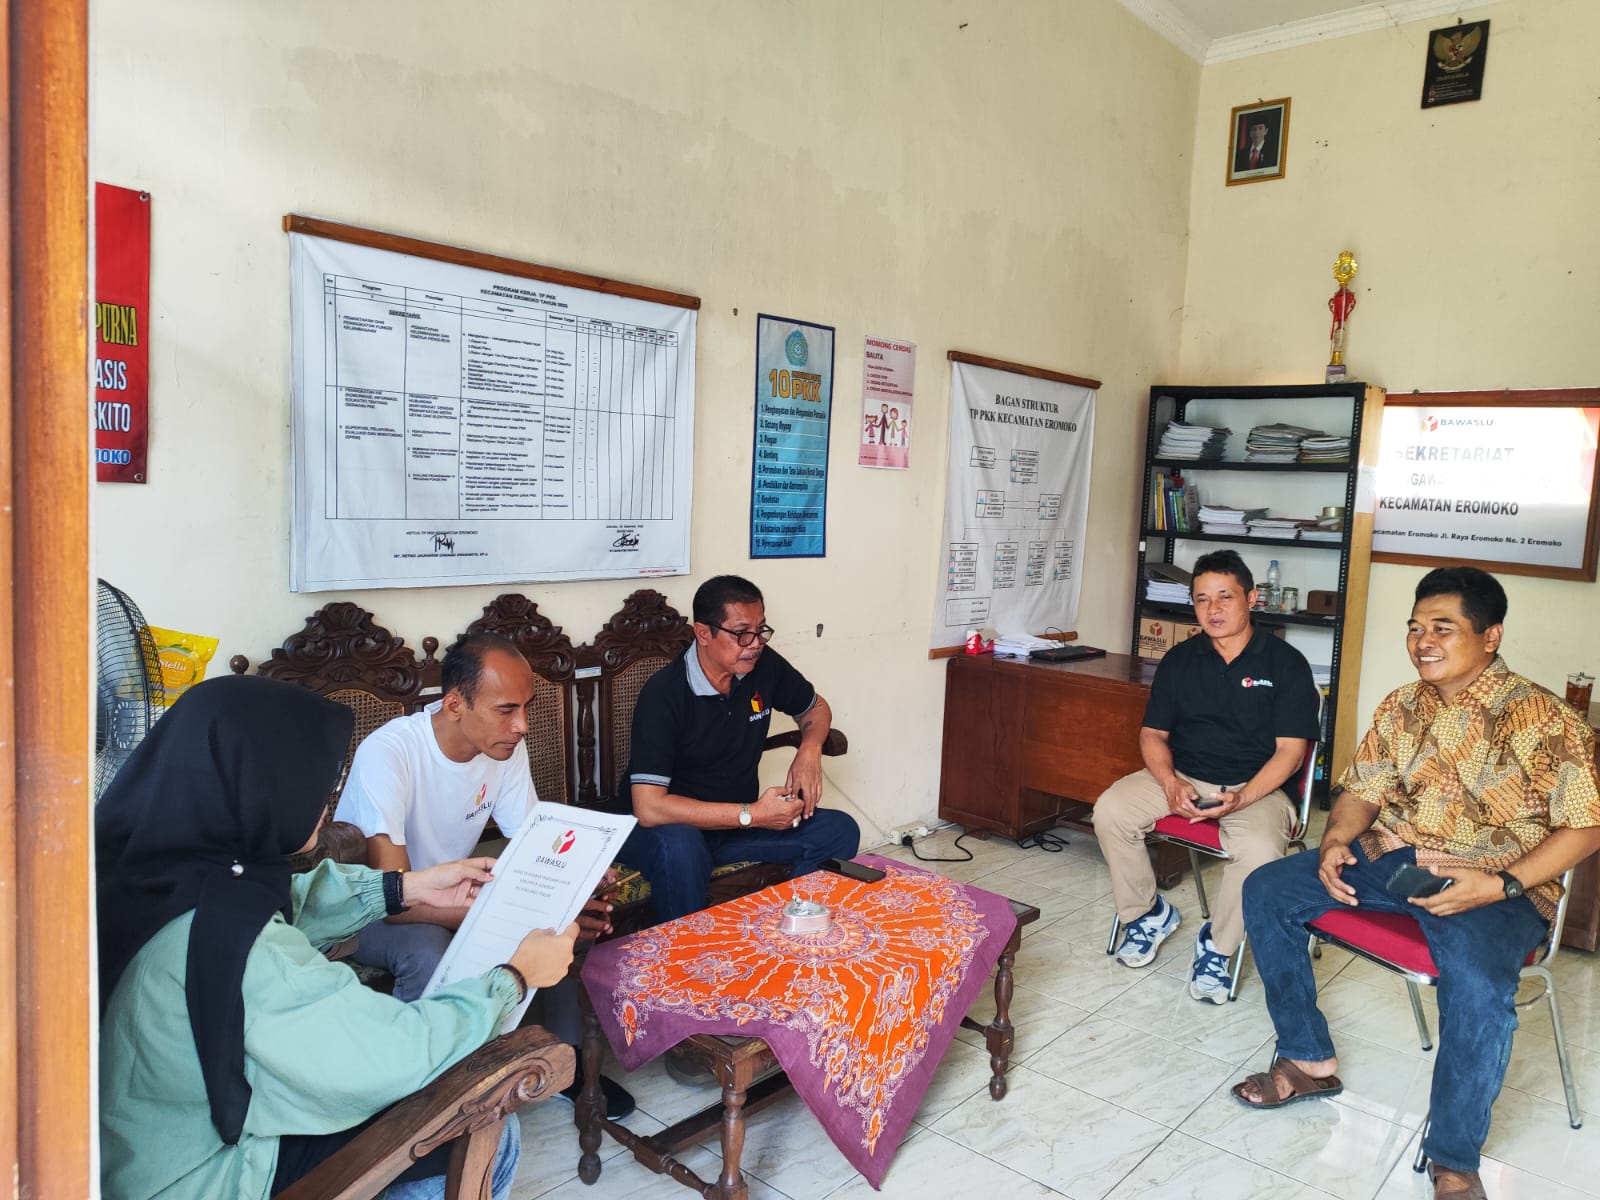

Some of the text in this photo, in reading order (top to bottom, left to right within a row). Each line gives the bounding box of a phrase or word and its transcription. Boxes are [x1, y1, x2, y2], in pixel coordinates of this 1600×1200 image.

[866, 351, 884, 360] BALITA
[769, 368, 822, 403] 10 PKK
[995, 394, 1059, 414] BAGAN STRUKTUR
[970, 408, 1077, 432] TP PKK KECAMATAN EROMOKO
[1440, 418, 1494, 427] BAWASLU
[1395, 445, 1515, 463] SEKRETARIAT
[1379, 496, 1519, 516] KECAMATAN EROMOKO
[1408, 530, 1439, 539] Eromoko
[1451, 533, 1469, 542] Raya
[1471, 533, 1504, 543] Eromoko
[1520, 537, 1526, 545] 2
[1527, 537, 1563, 547] Eromoko
[535, 855, 568, 869] BAWASLU
